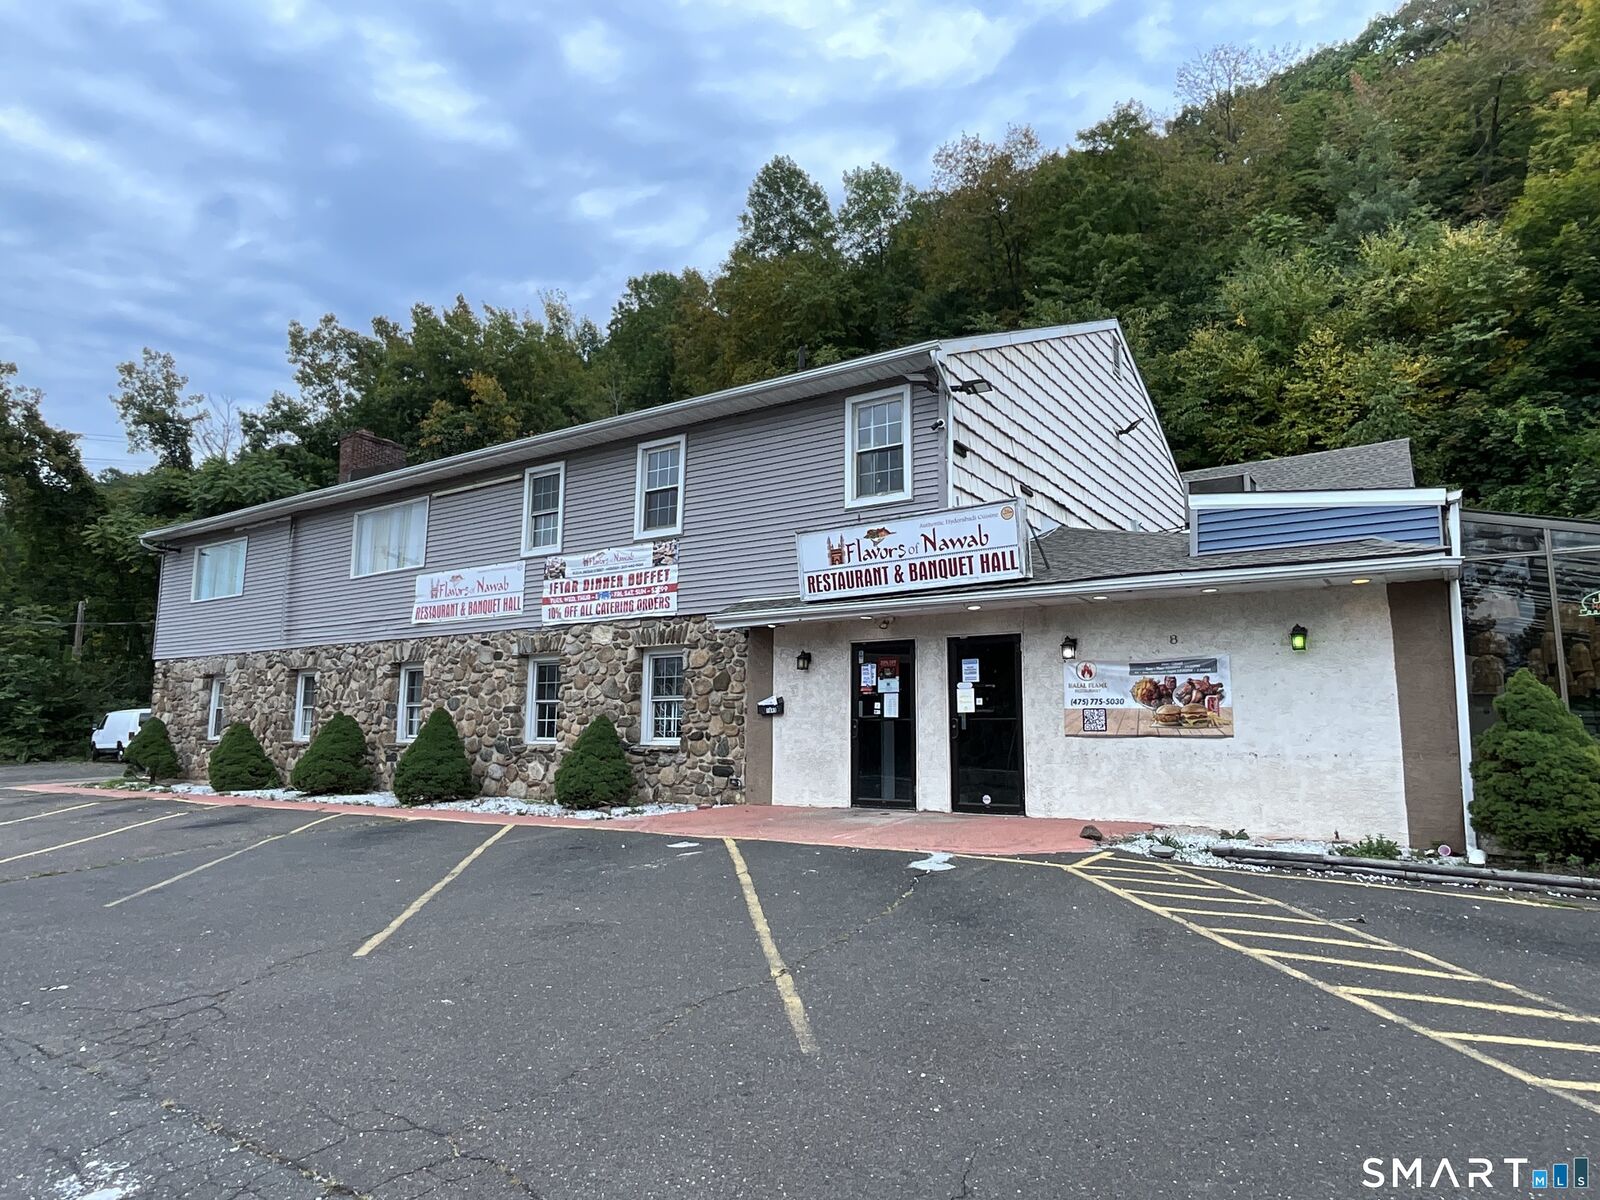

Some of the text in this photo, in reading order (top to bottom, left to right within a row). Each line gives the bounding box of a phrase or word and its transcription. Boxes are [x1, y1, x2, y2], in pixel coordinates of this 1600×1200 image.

[845, 524, 989, 563] Flavors of Nawab
[549, 580, 579, 595] IFTAR
[583, 575, 624, 592] DINNER
[628, 568, 671, 587] BUFFET
[807, 566, 889, 594] RESTAURANT
[894, 564, 905, 584] &
[908, 555, 974, 582] BANQUET
[979, 550, 1019, 574] HALL
[440, 581, 469, 600] Flavors
[476, 576, 509, 594] Nawab
[415, 596, 521, 620] RESTAURANT & BANQUET HALL
[548, 596, 671, 620] 10% OFF ALL CATERING ORDERS
[1169, 635, 1179, 645] 8
[1070, 698, 1125, 707] (475) 775-5030
